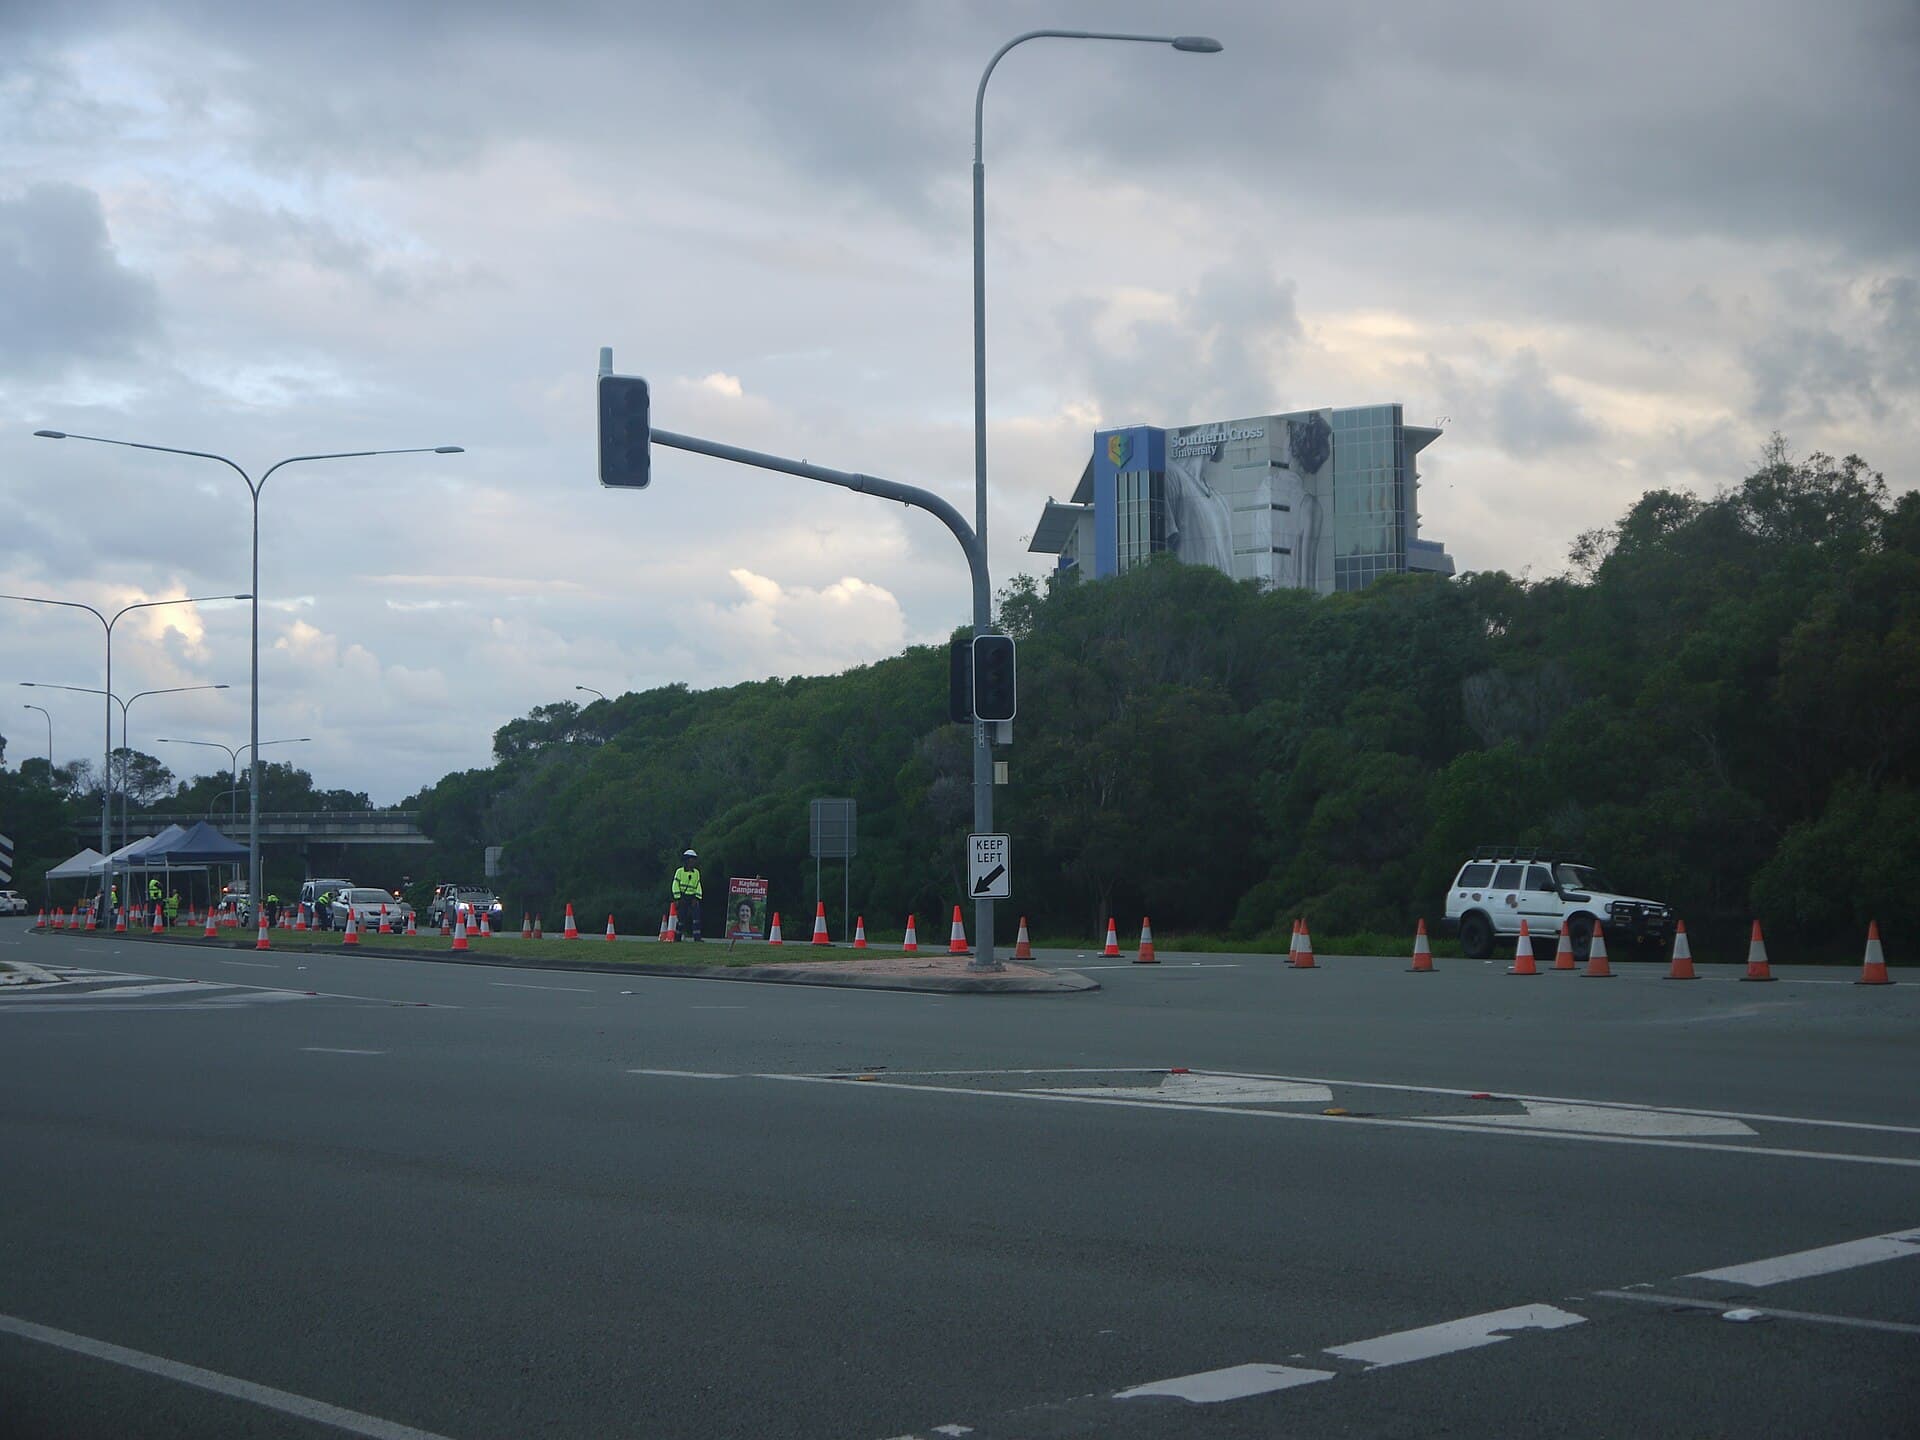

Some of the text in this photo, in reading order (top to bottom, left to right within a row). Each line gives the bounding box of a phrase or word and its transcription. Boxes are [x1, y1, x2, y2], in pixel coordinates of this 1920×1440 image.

[1171, 428, 1263, 447] Southern Cross
[1172, 444, 1217, 458] University
[976, 839, 1003, 850] KEEP
[977, 853, 1002, 863] LEFT
